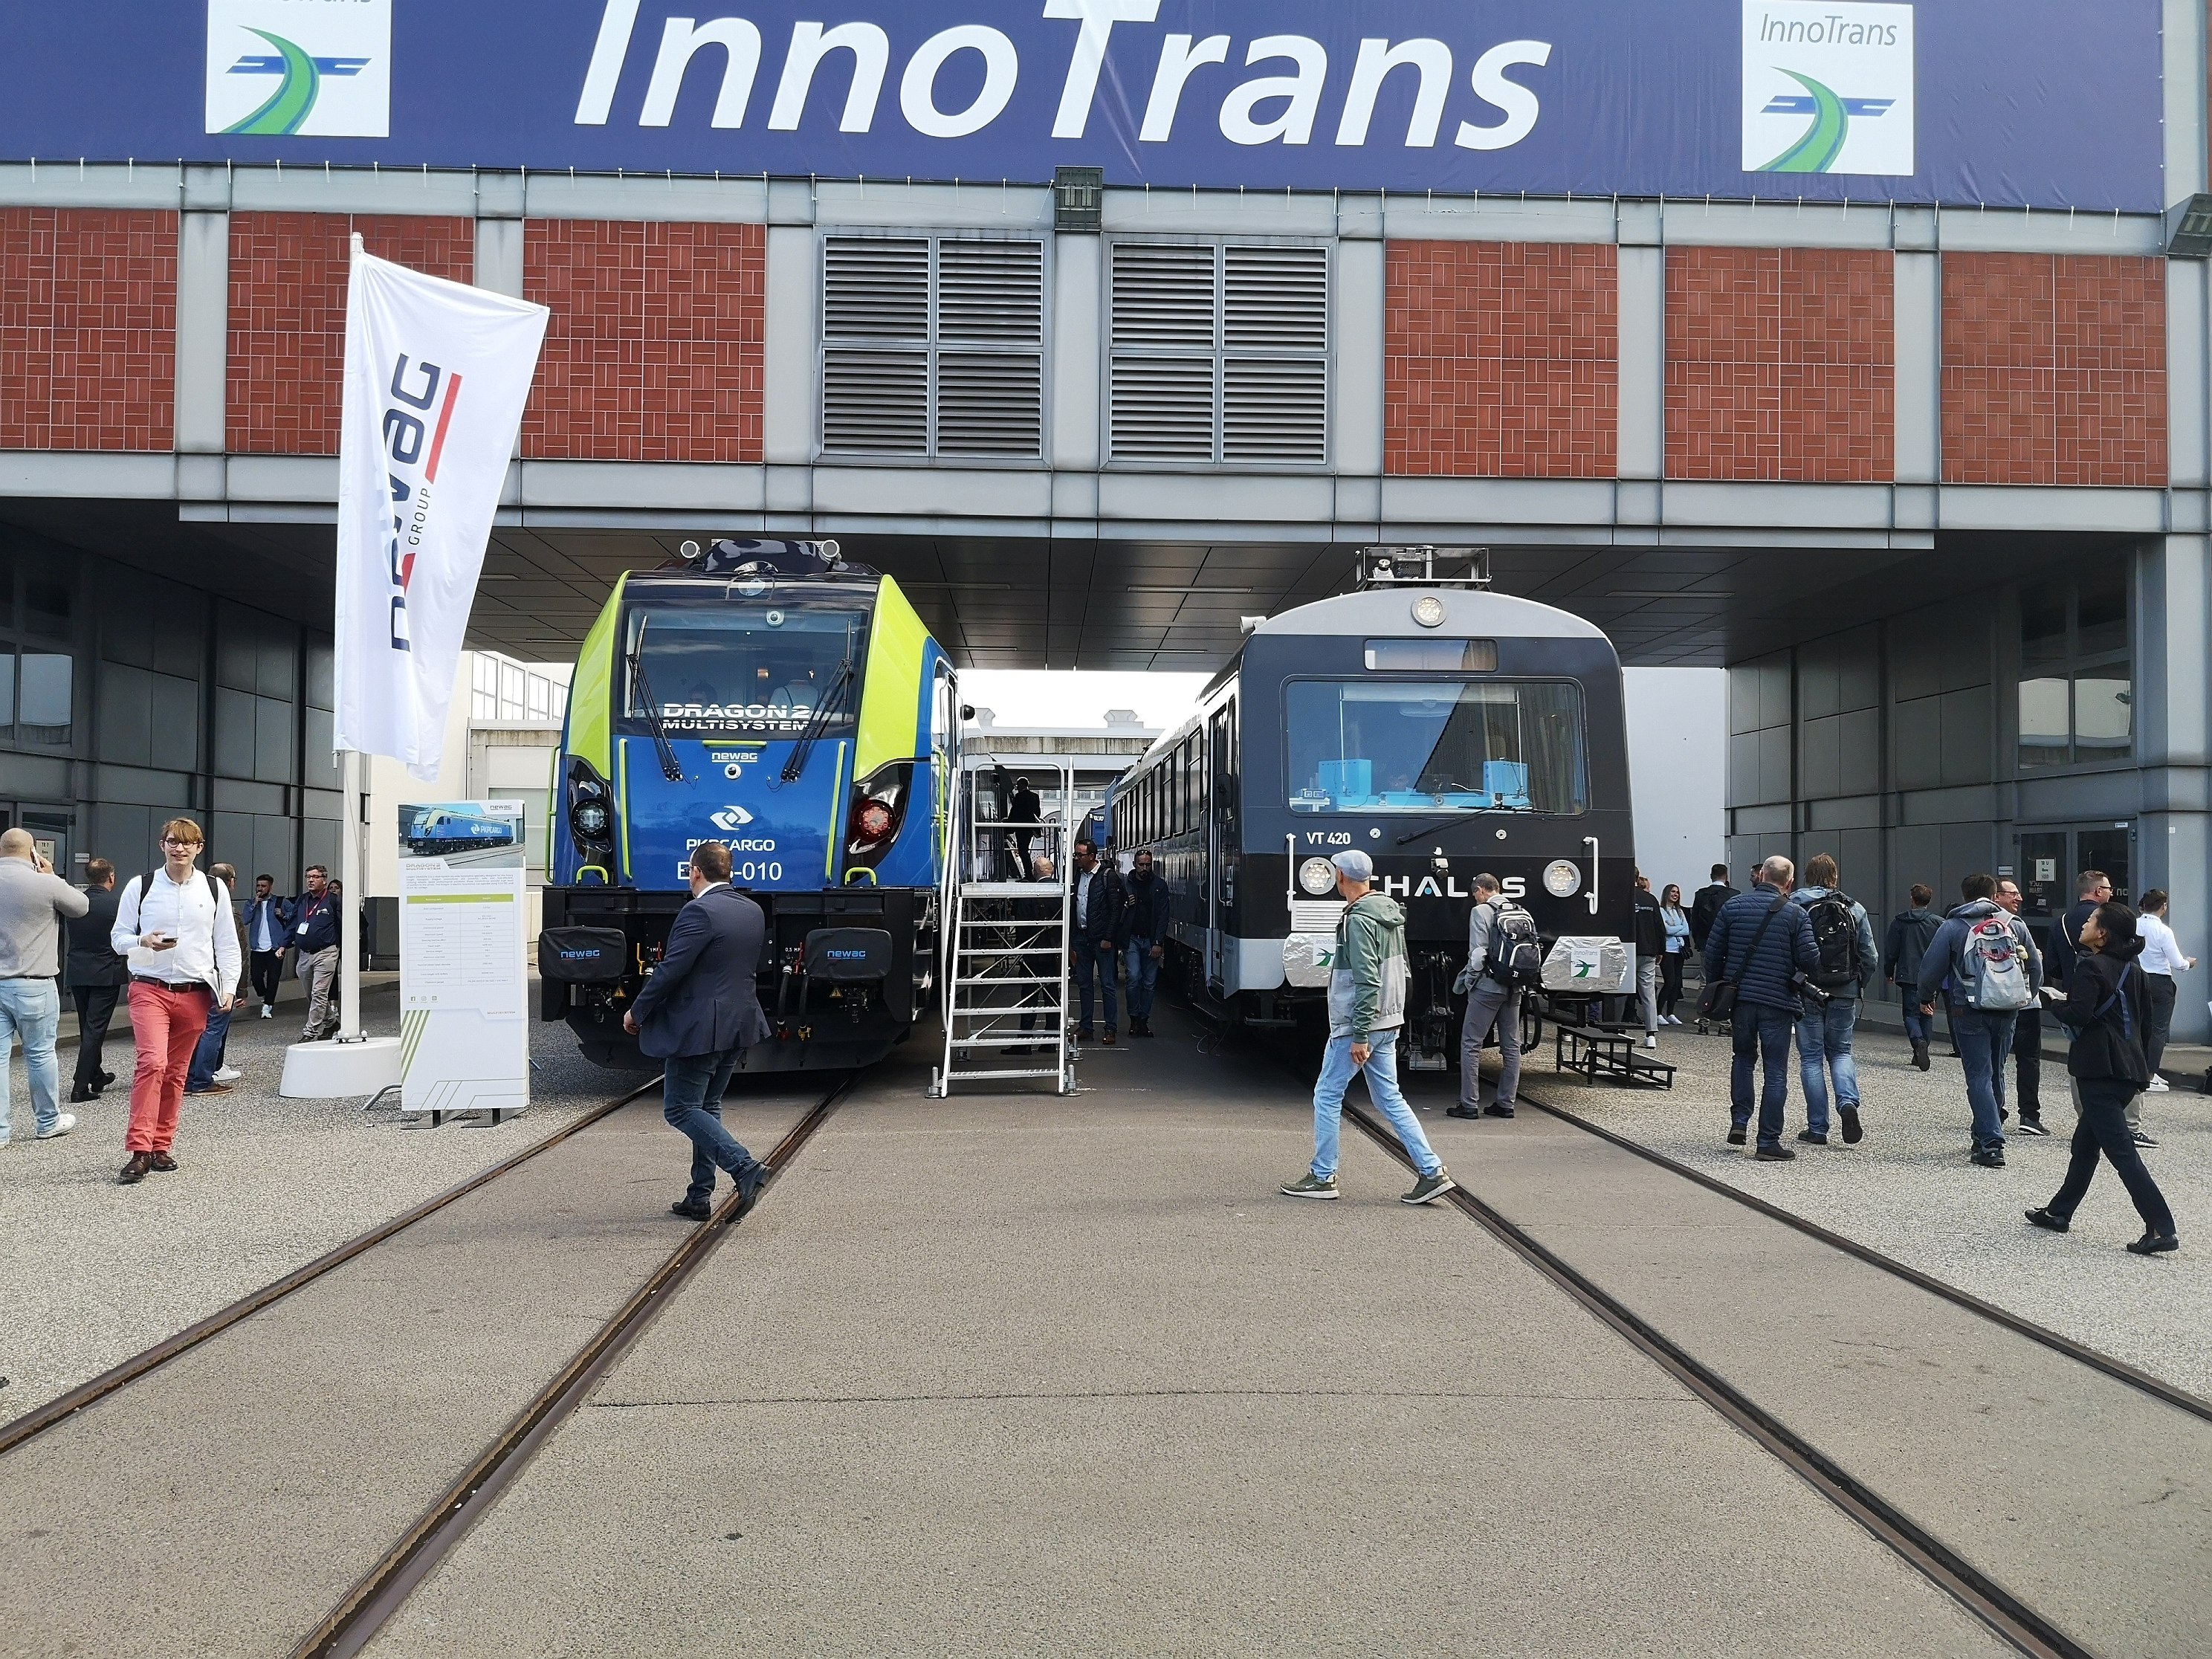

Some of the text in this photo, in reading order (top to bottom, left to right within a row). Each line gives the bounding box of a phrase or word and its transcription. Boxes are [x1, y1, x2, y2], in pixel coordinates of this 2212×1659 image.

[1759, 13, 1898, 46] InnoTrans
[575, 0, 1553, 149] InnoTrans
[408, 488, 432, 546] GROUP
[663, 703, 810, 719] DRAGON 2
[662, 719, 809, 731] MULTISYSTEM
[1306, 832, 1351, 845] VT 420
[1369, 876, 1526, 898] HALS
